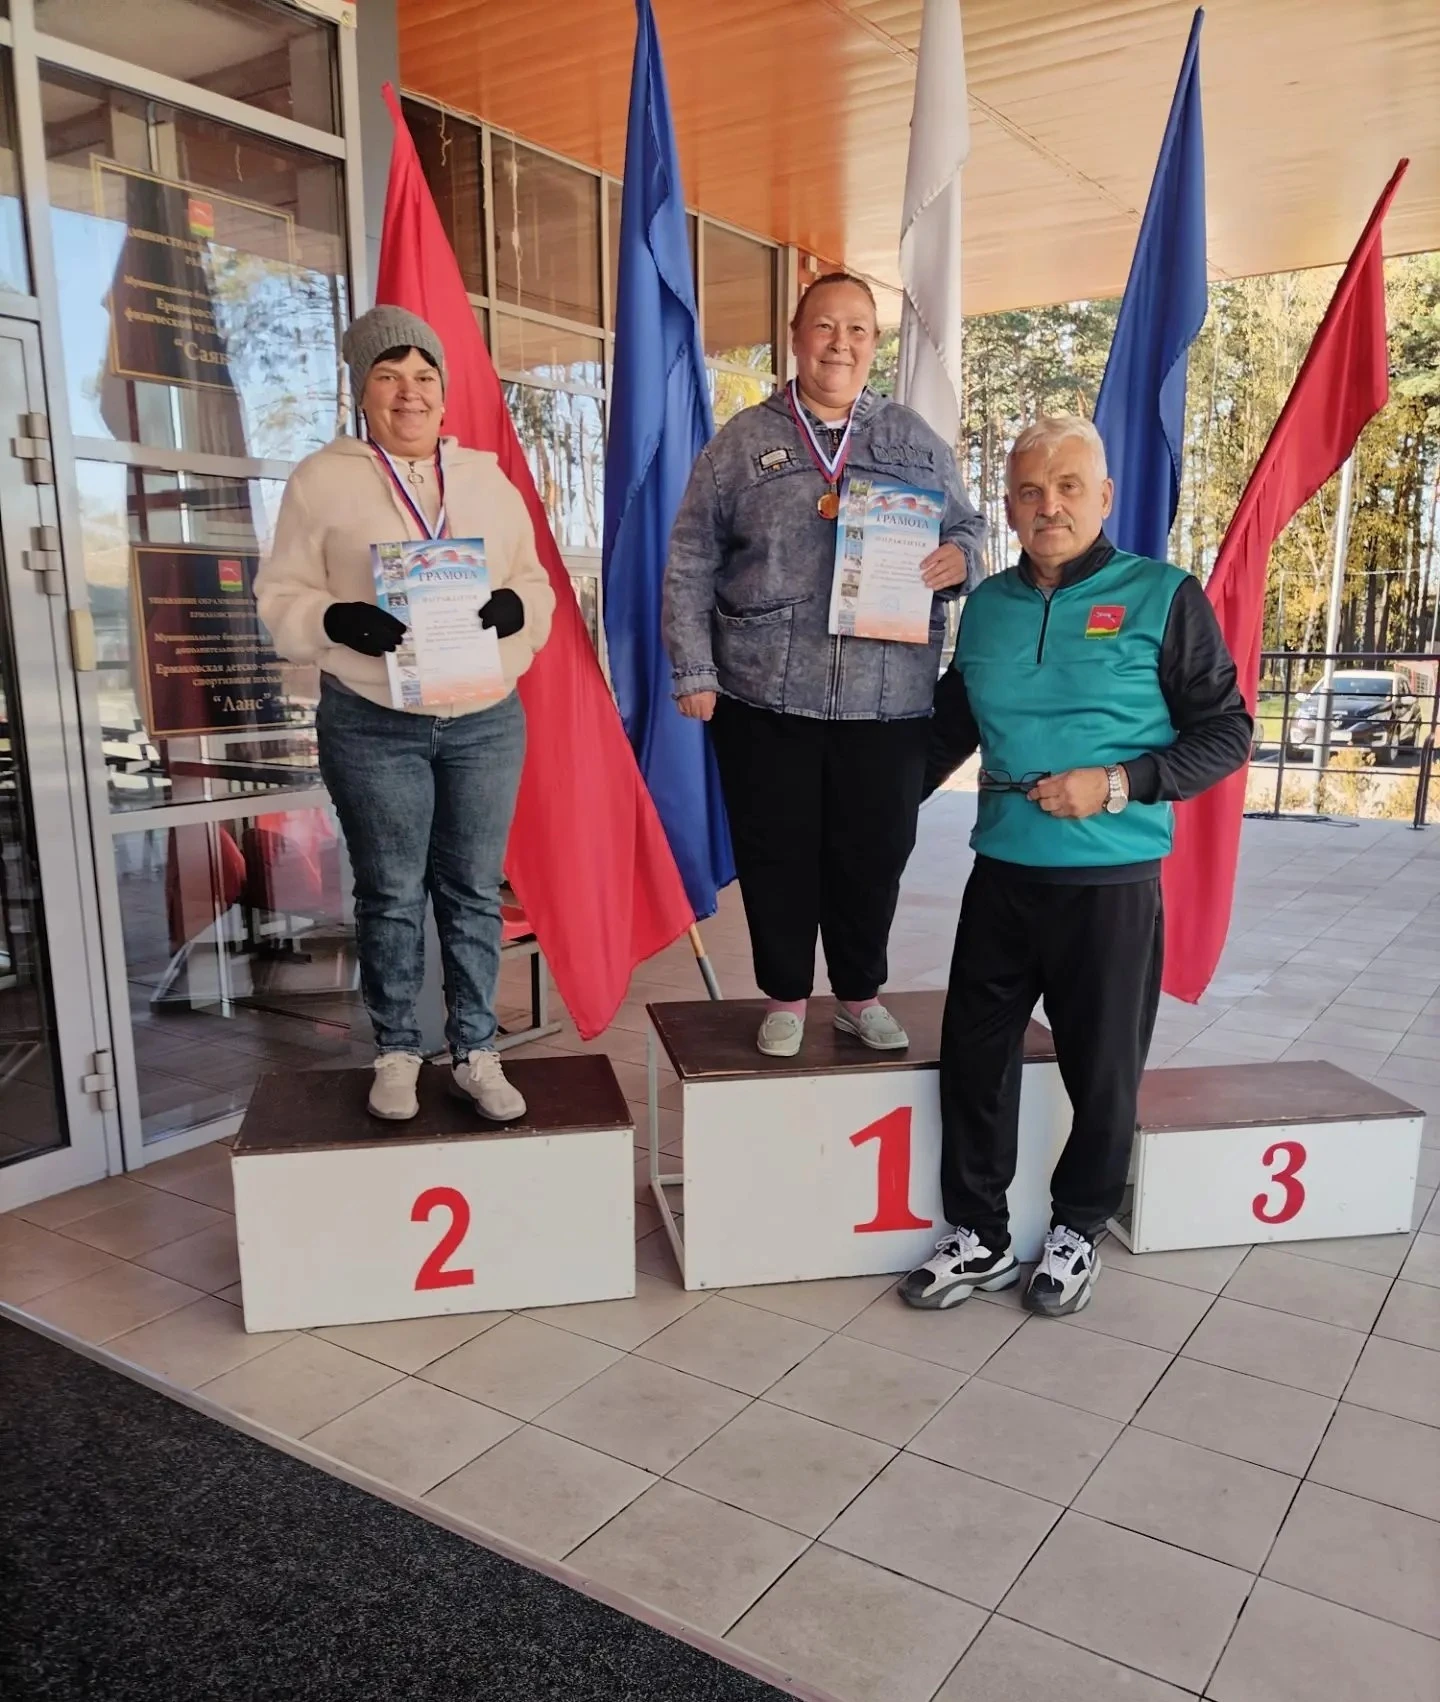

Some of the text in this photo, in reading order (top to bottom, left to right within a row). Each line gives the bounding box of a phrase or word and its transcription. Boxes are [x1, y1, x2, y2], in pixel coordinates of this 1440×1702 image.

[876, 512, 930, 529] ГРАМОТА
[418, 570, 478, 582] ГРАМОТА
[155, 663, 223, 677] Ермаковская
[849, 1106, 933, 1233] 1
[1252, 1140, 1307, 1224] 3
[410, 1186, 475, 1291] 2
